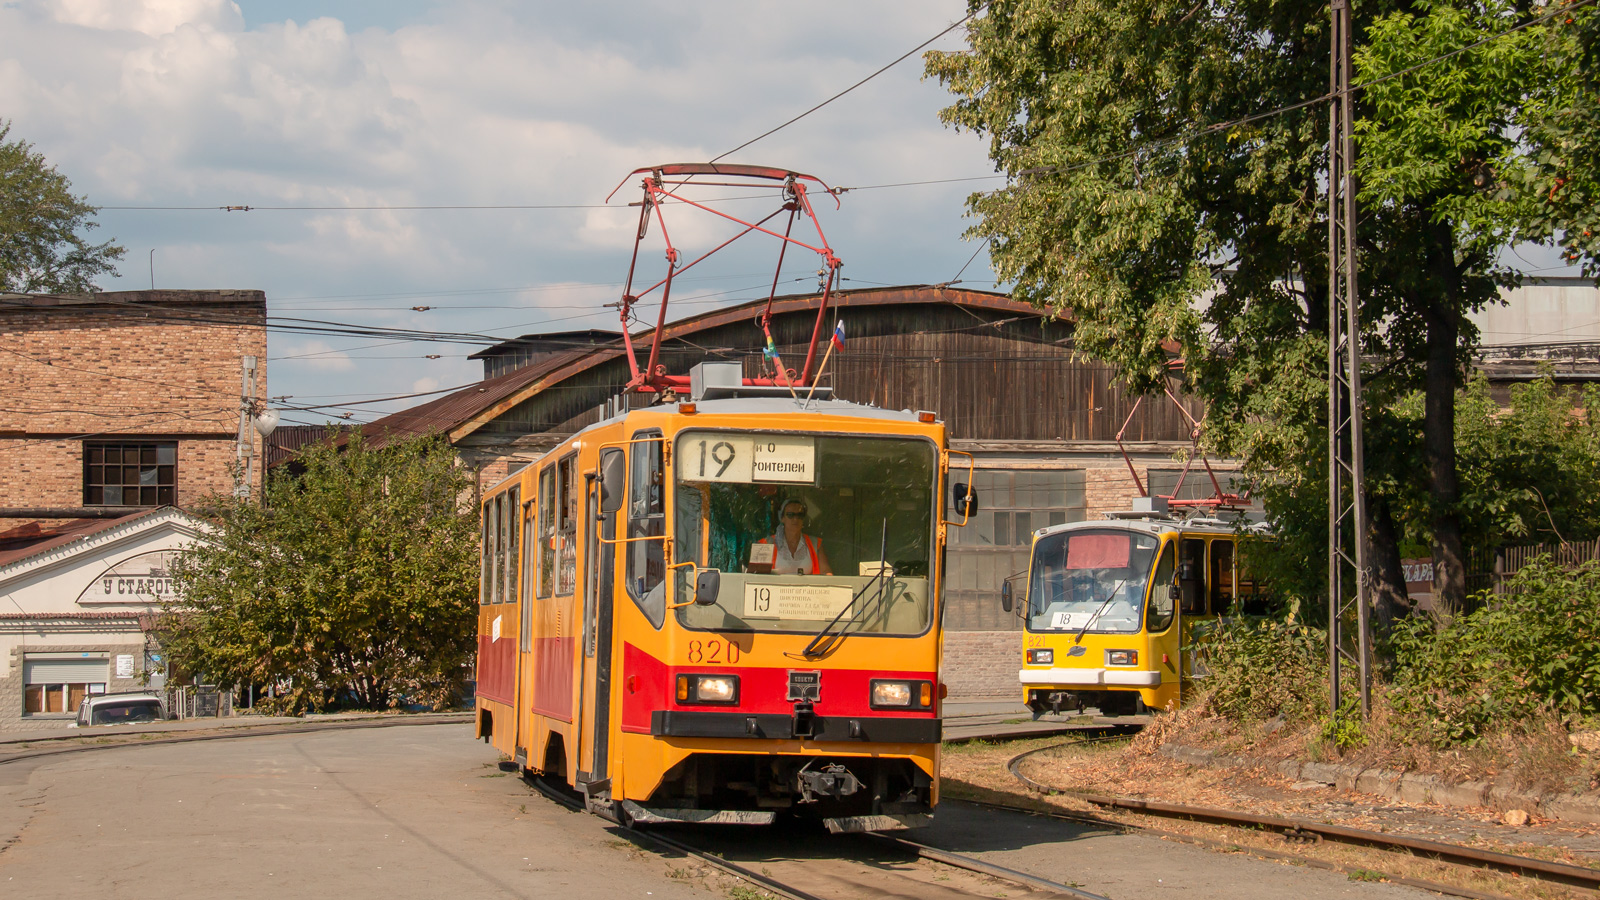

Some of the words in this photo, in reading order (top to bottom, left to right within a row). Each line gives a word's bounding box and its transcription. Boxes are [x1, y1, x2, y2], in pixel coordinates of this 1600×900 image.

[699, 440, 736, 478] 19
[103, 579, 113, 595] У
[753, 587, 771, 612] 19
[1059, 613, 1072, 625] 18
[1028, 635, 1046, 647] 821
[688, 640, 740, 664] 820
